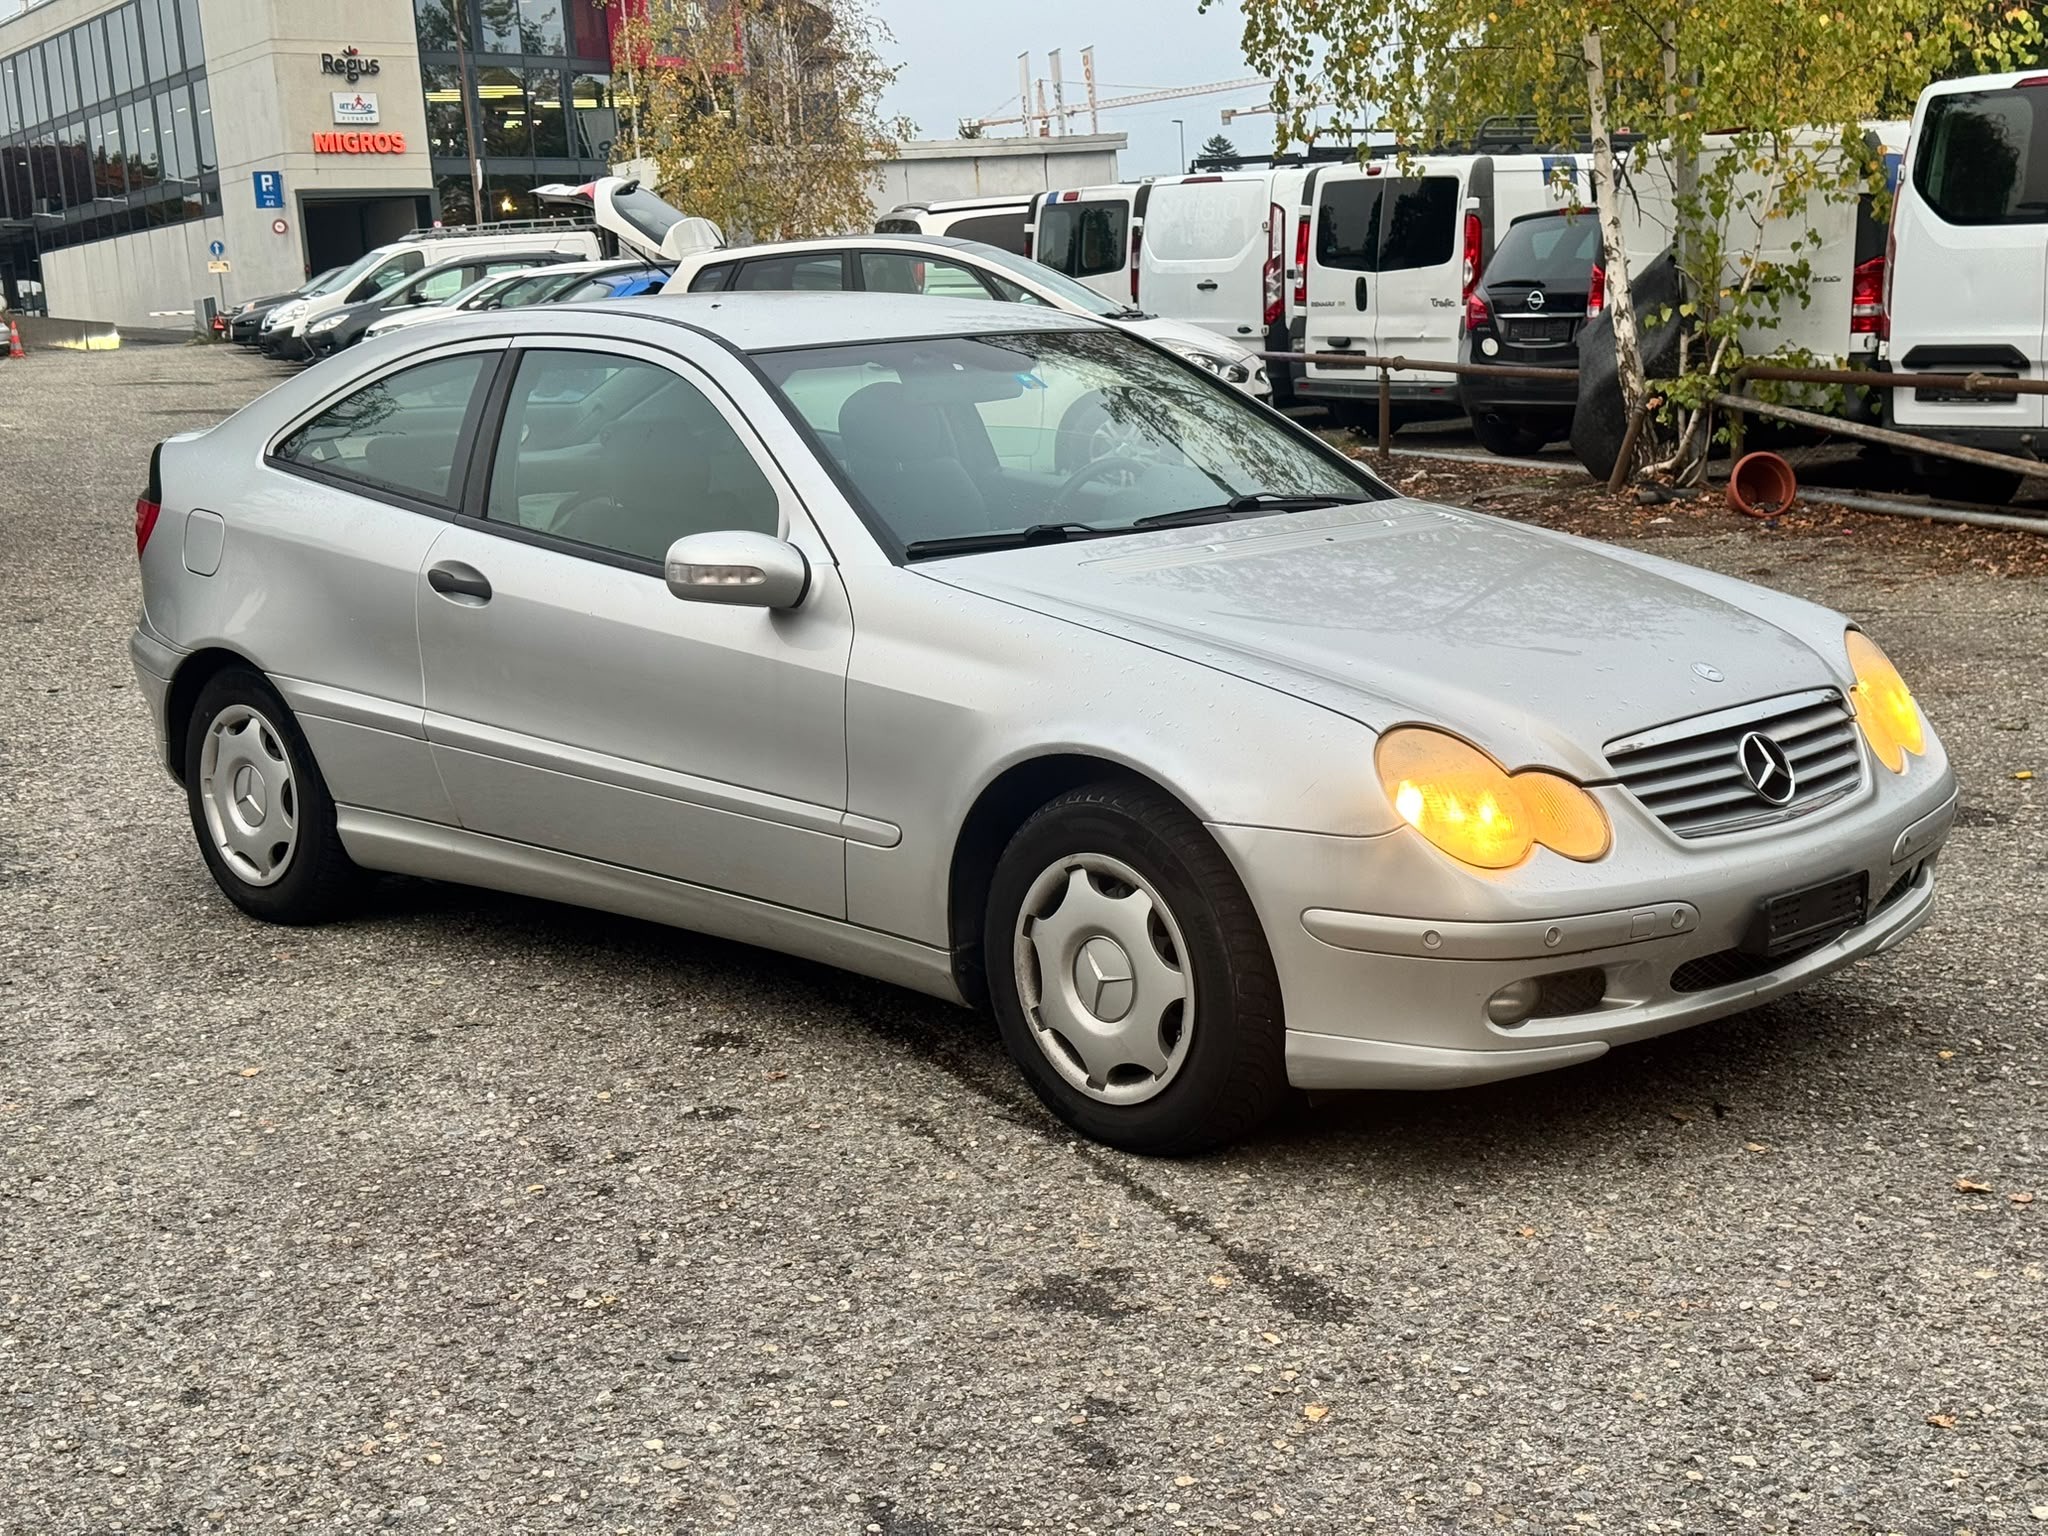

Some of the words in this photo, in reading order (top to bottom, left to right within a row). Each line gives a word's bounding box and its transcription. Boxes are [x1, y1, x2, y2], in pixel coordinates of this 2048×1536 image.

[321, 53, 381, 82] Regus
[313, 131, 407, 153] MIGROS
[261, 174, 273, 192] P
